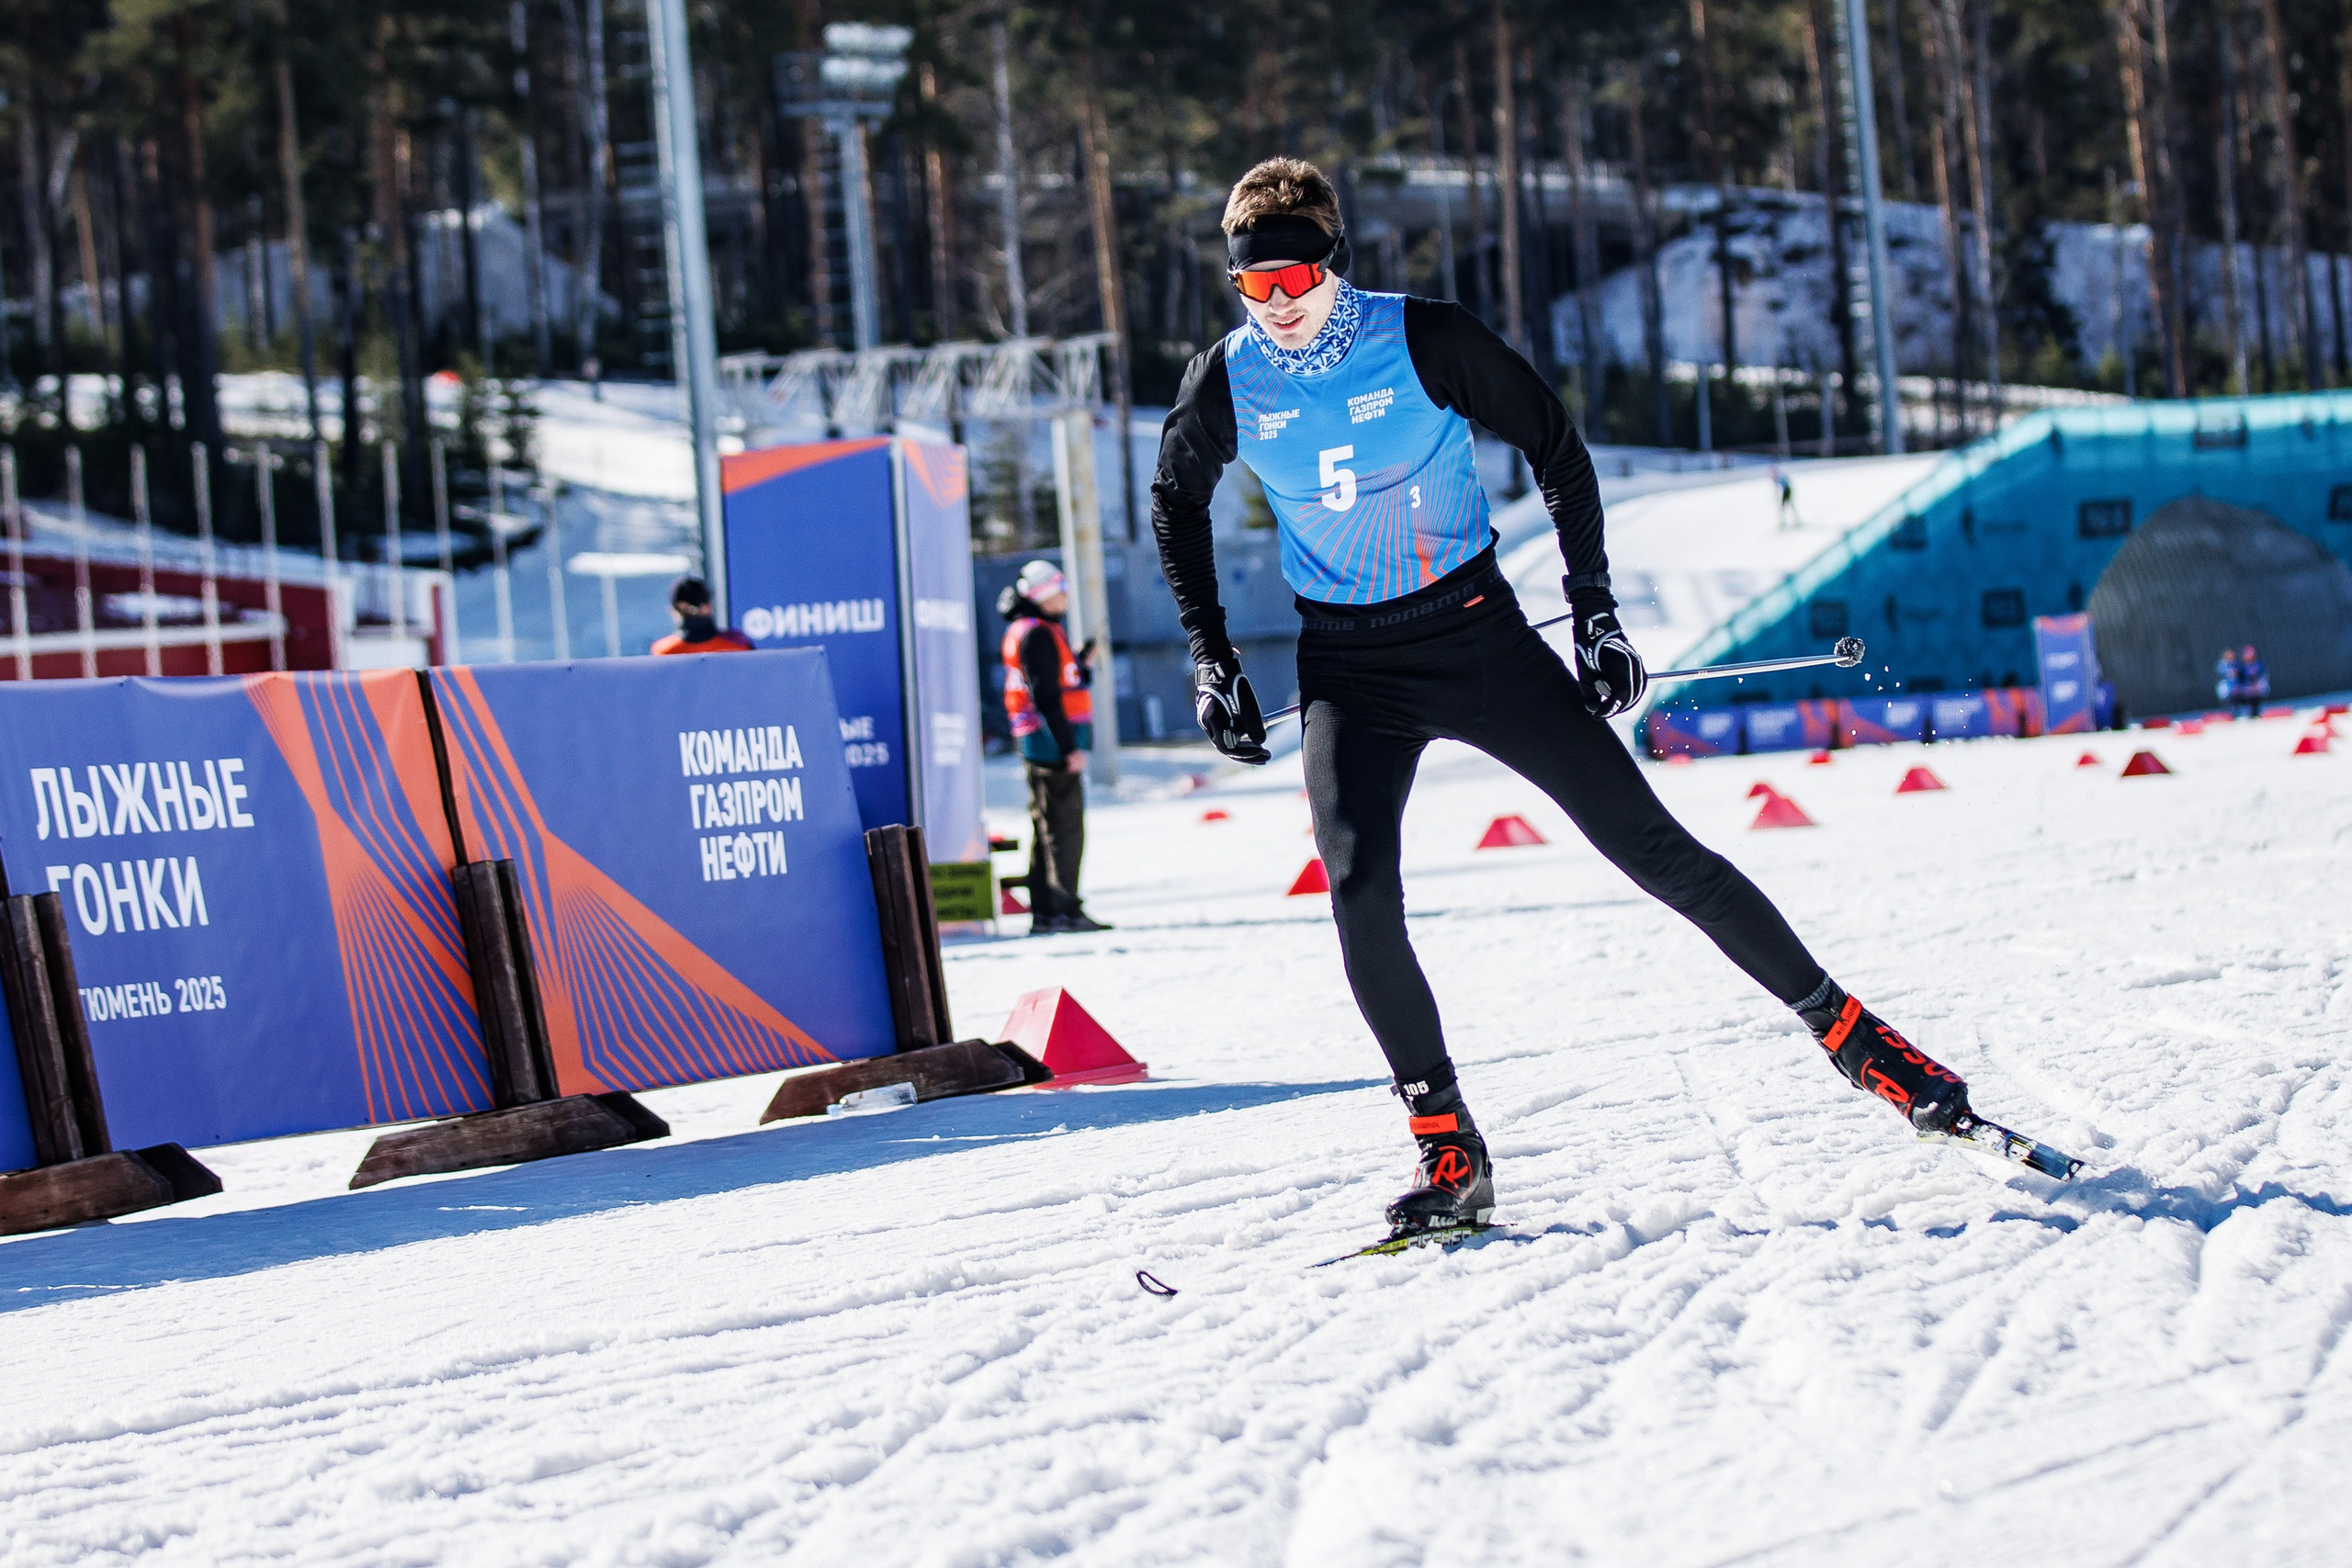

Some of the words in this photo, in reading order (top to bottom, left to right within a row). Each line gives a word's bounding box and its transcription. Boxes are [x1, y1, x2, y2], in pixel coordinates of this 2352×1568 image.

[1347, 387, 1395, 407] КОМАНДА
[1349, 396, 1393, 416] ГАЗПРОМ
[1259, 409, 1300, 423] ЛЫЖНЫЕ
[1260, 420, 1287, 432] ГОНКИ
[1351, 407, 1385, 424] НЕФТИ
[1260, 430, 1278, 441] 2025
[1318, 445, 1357, 512] 5
[1408, 485, 1422, 509] 3
[1370, 581, 1476, 629] noname
[741, 599, 885, 639] ФИНИШ
[679, 725, 805, 776] КОМАНДА
[844, 742, 889, 768] 025
[29, 758, 255, 840] ЛЫЖНЫЕ
[689, 776, 804, 829] ГАЗПРОМ
[700, 830, 788, 882] НЕФТИ
[174, 975, 227, 1013] 2025
[1403, 1080, 1430, 1096] 105
